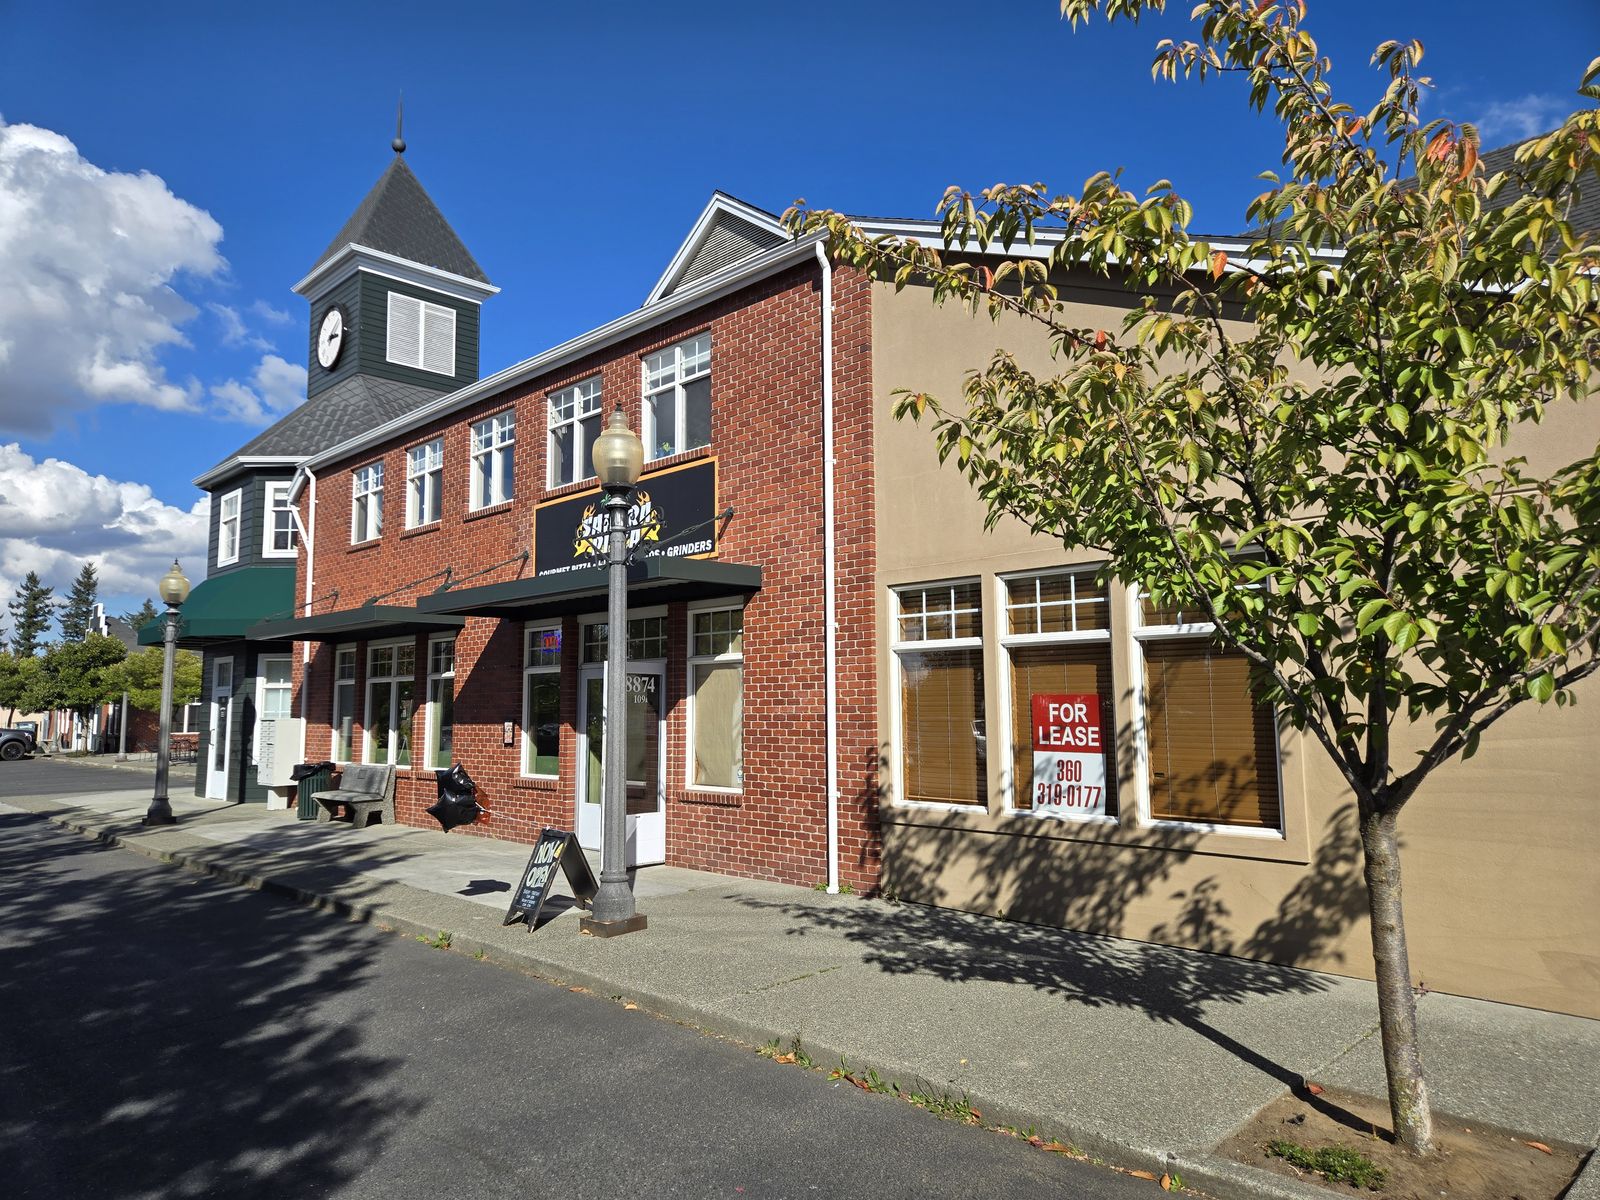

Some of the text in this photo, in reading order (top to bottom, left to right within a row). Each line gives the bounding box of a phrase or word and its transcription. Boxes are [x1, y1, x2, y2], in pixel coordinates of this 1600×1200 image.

[590, 529, 641, 557] PIA
[666, 539, 713, 557] GRINDERS
[1048, 703, 1088, 723] FOR
[1038, 725, 1100, 747] LEASE
[1056, 759, 1082, 782] 360
[1037, 782, 1102, 809] 319-0177
[534, 840, 560, 864] NOW
